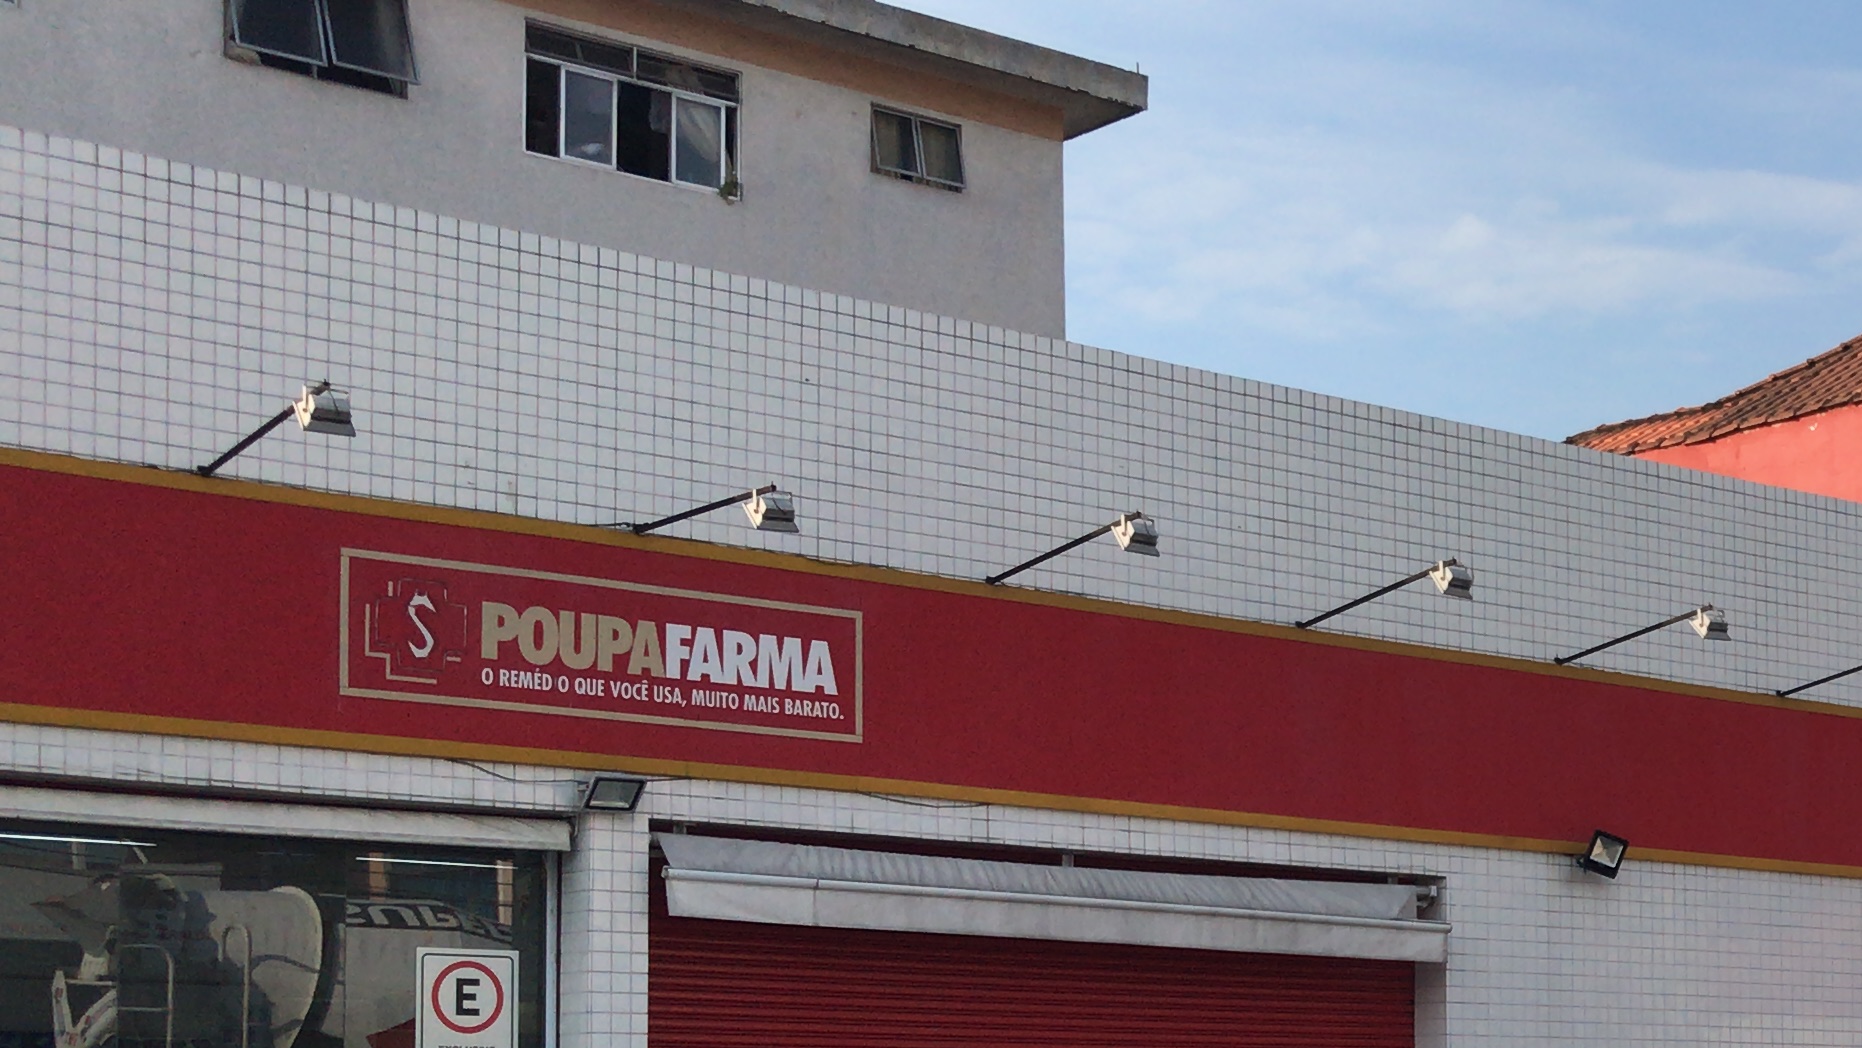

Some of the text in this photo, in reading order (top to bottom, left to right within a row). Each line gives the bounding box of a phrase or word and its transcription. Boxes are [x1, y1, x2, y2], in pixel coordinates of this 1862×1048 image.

[481, 600, 839, 696] POUPAFARMA
[481, 667, 845, 720] O REMÉDO QUE VOCÊ USA, MUITO MAIS BARATO.
[455, 977, 481, 1017] E
